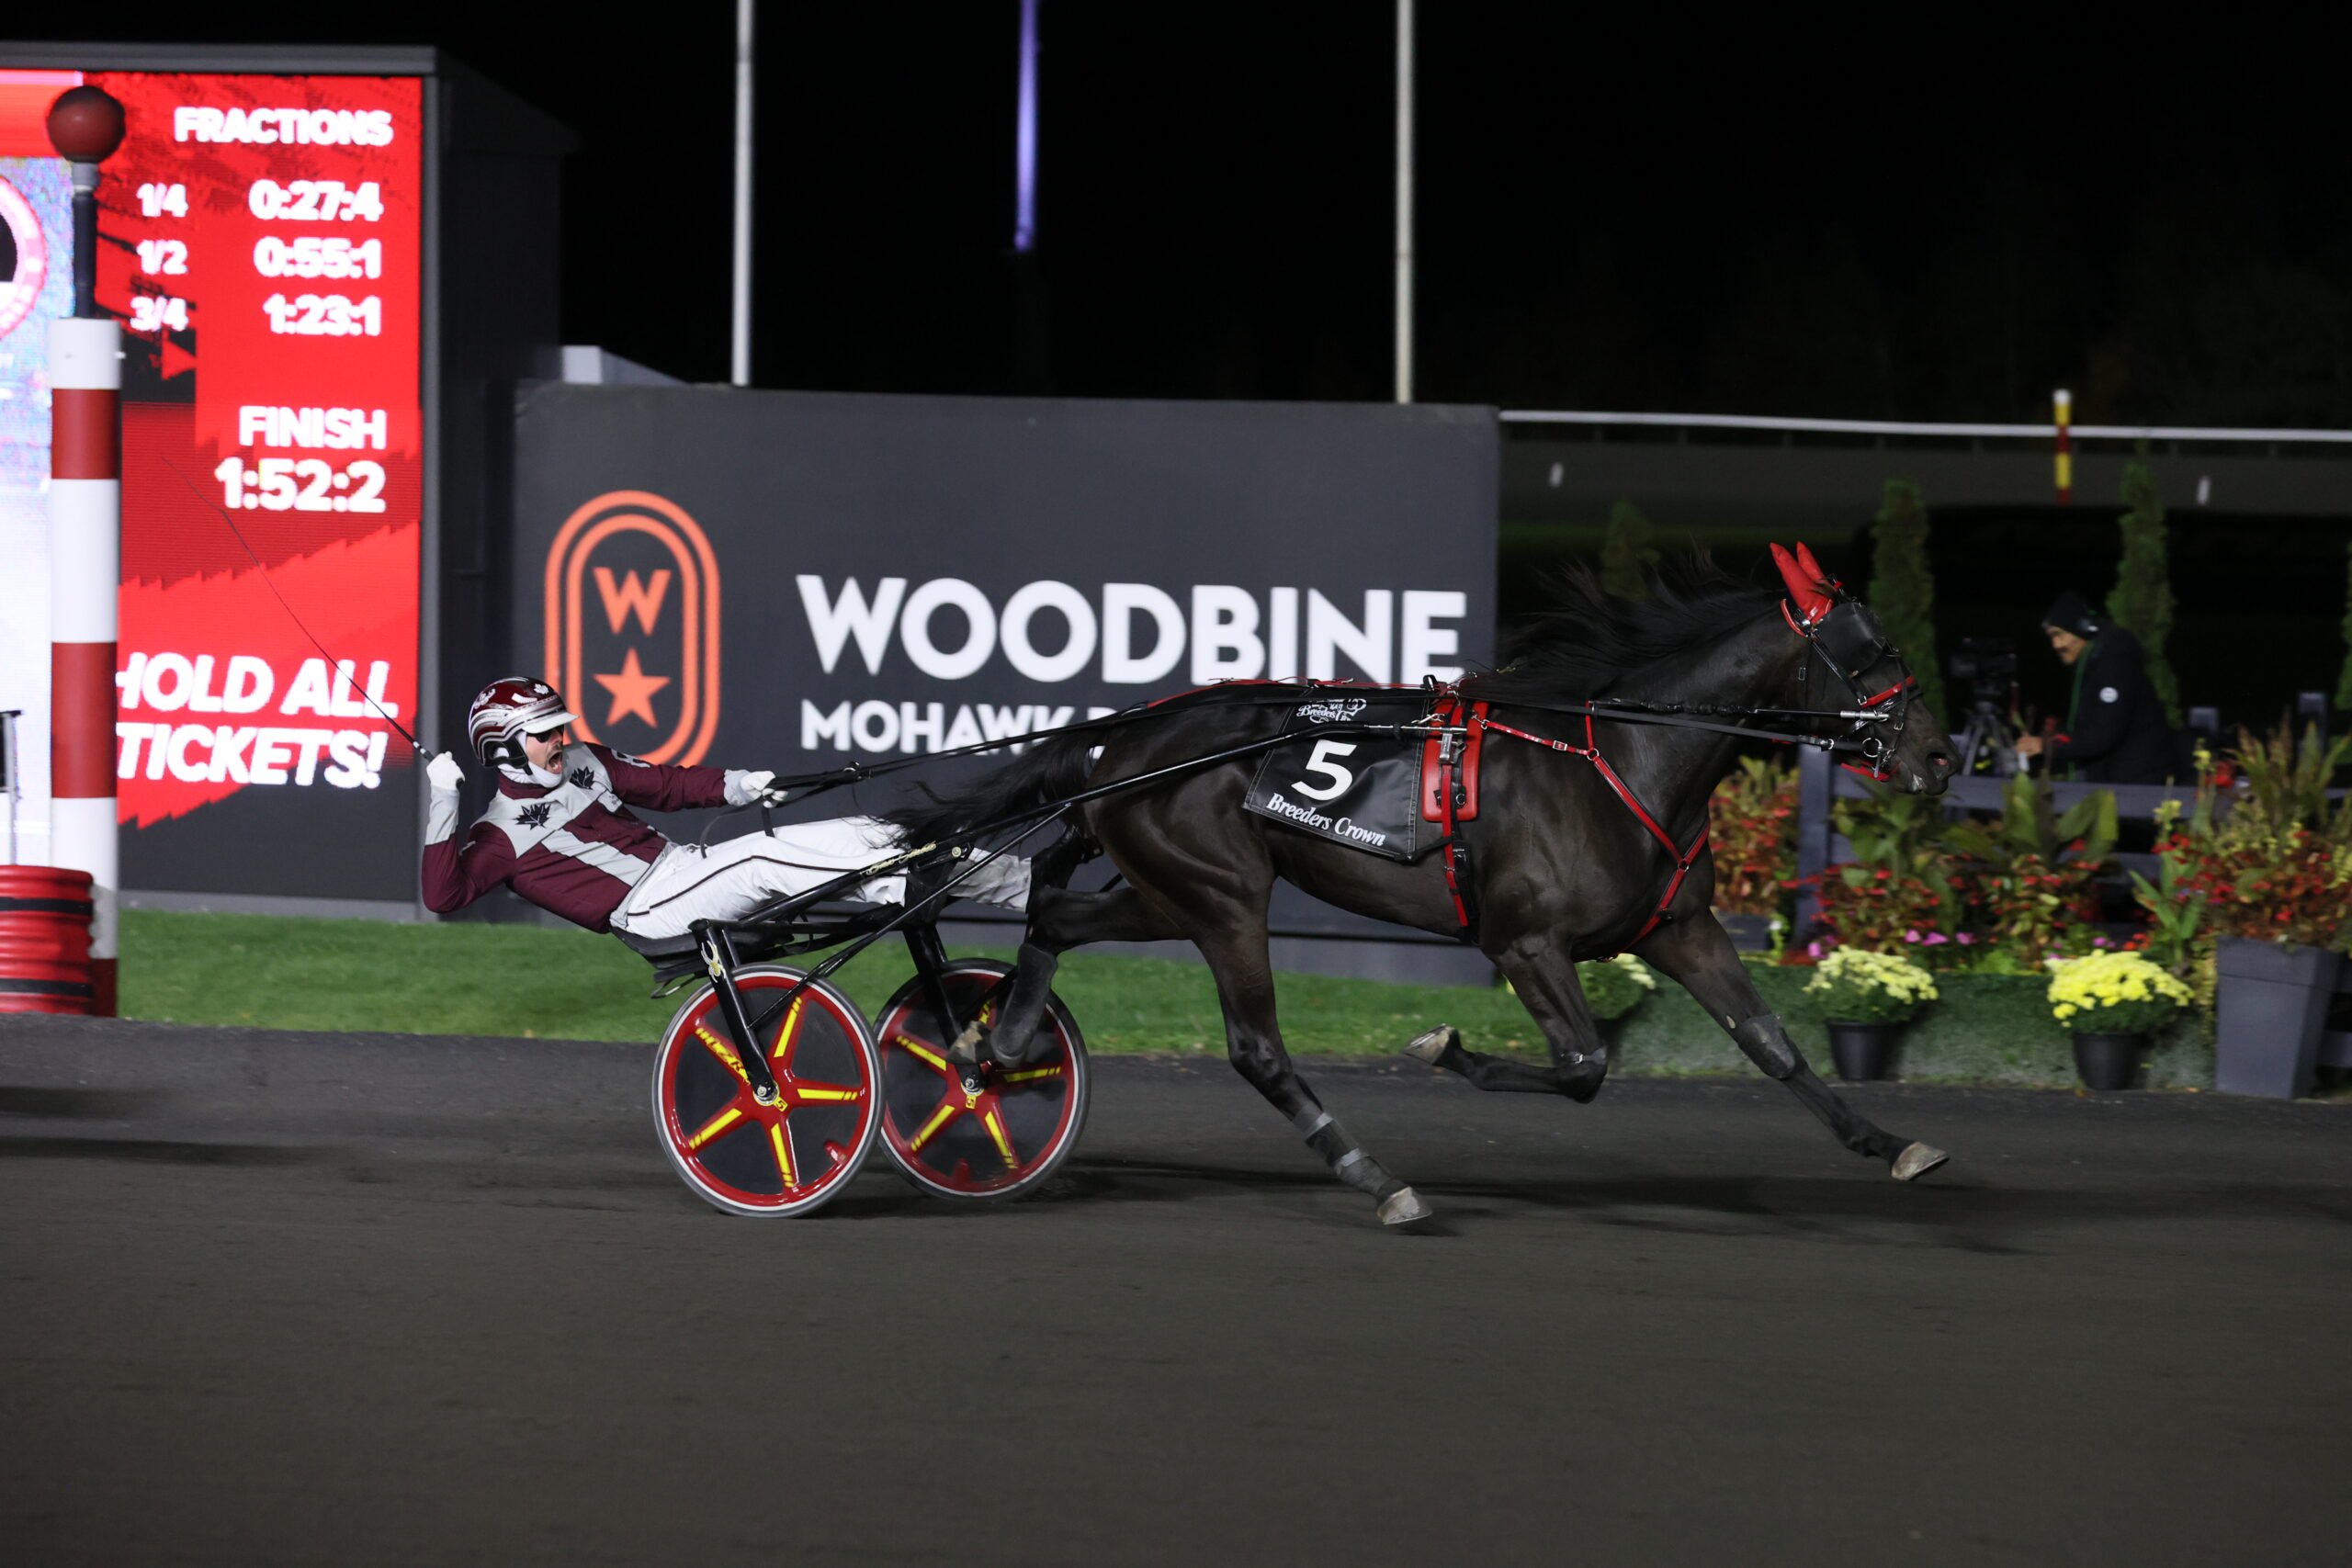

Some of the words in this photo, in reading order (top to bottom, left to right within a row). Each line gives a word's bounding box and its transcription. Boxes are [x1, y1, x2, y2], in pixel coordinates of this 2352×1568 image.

[175, 107, 394, 146] FRACTIONS
[136, 183, 189, 218] 1/4
[249, 179, 384, 221] 0:27:4
[136, 240, 189, 275] 1/2
[254, 236, 382, 278] 0:55:1
[130, 296, 189, 332] 3/4
[263, 293, 381, 336] 1:23:1
[238, 405, 388, 449] FINISH
[214, 457, 386, 513] 1:52:2
[593, 567, 672, 636] W
[796, 573, 1467, 686] WOODBINE
[279, 658, 399, 719] ALL
[801, 698, 1076, 757] MOHAWK
[116, 722, 388, 790] TICKETS!
[1291, 739, 1358, 801] 5
[1266, 792, 1332, 830] Breeders
[1334, 817, 1386, 847] Crown
